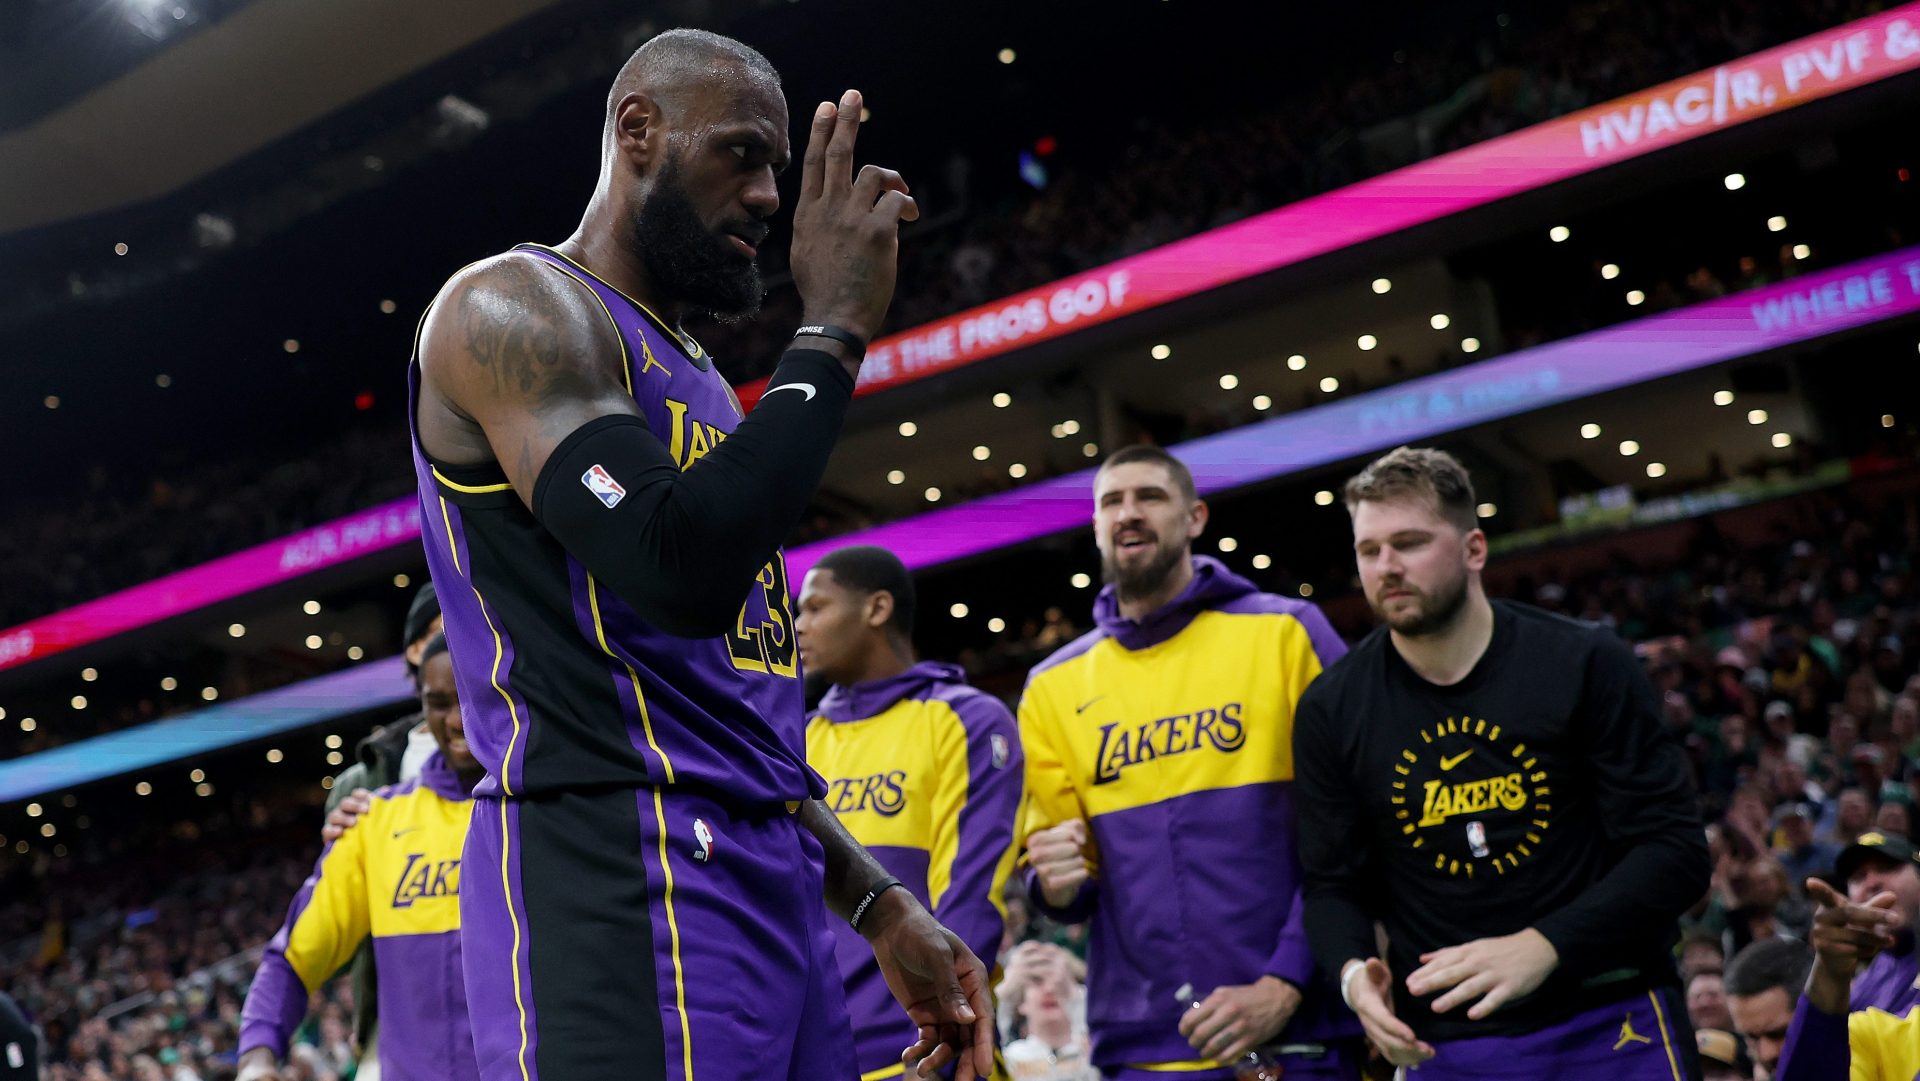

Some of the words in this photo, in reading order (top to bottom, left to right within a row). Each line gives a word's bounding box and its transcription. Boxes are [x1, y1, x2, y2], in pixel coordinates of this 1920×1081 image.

[1781, 30, 1872, 94] PVF
[897, 325, 955, 373] THE
[959, 298, 1047, 355] PROS
[1050, 279, 1107, 325] GO
[1752, 267, 1894, 331] WHERE
[794, 325, 825, 338] OMISE
[1093, 702, 1247, 785] LAKERS
[832, 770, 907, 818] ERS
[1418, 773, 1528, 828] LAKERS
[393, 854, 460, 907] LAK
